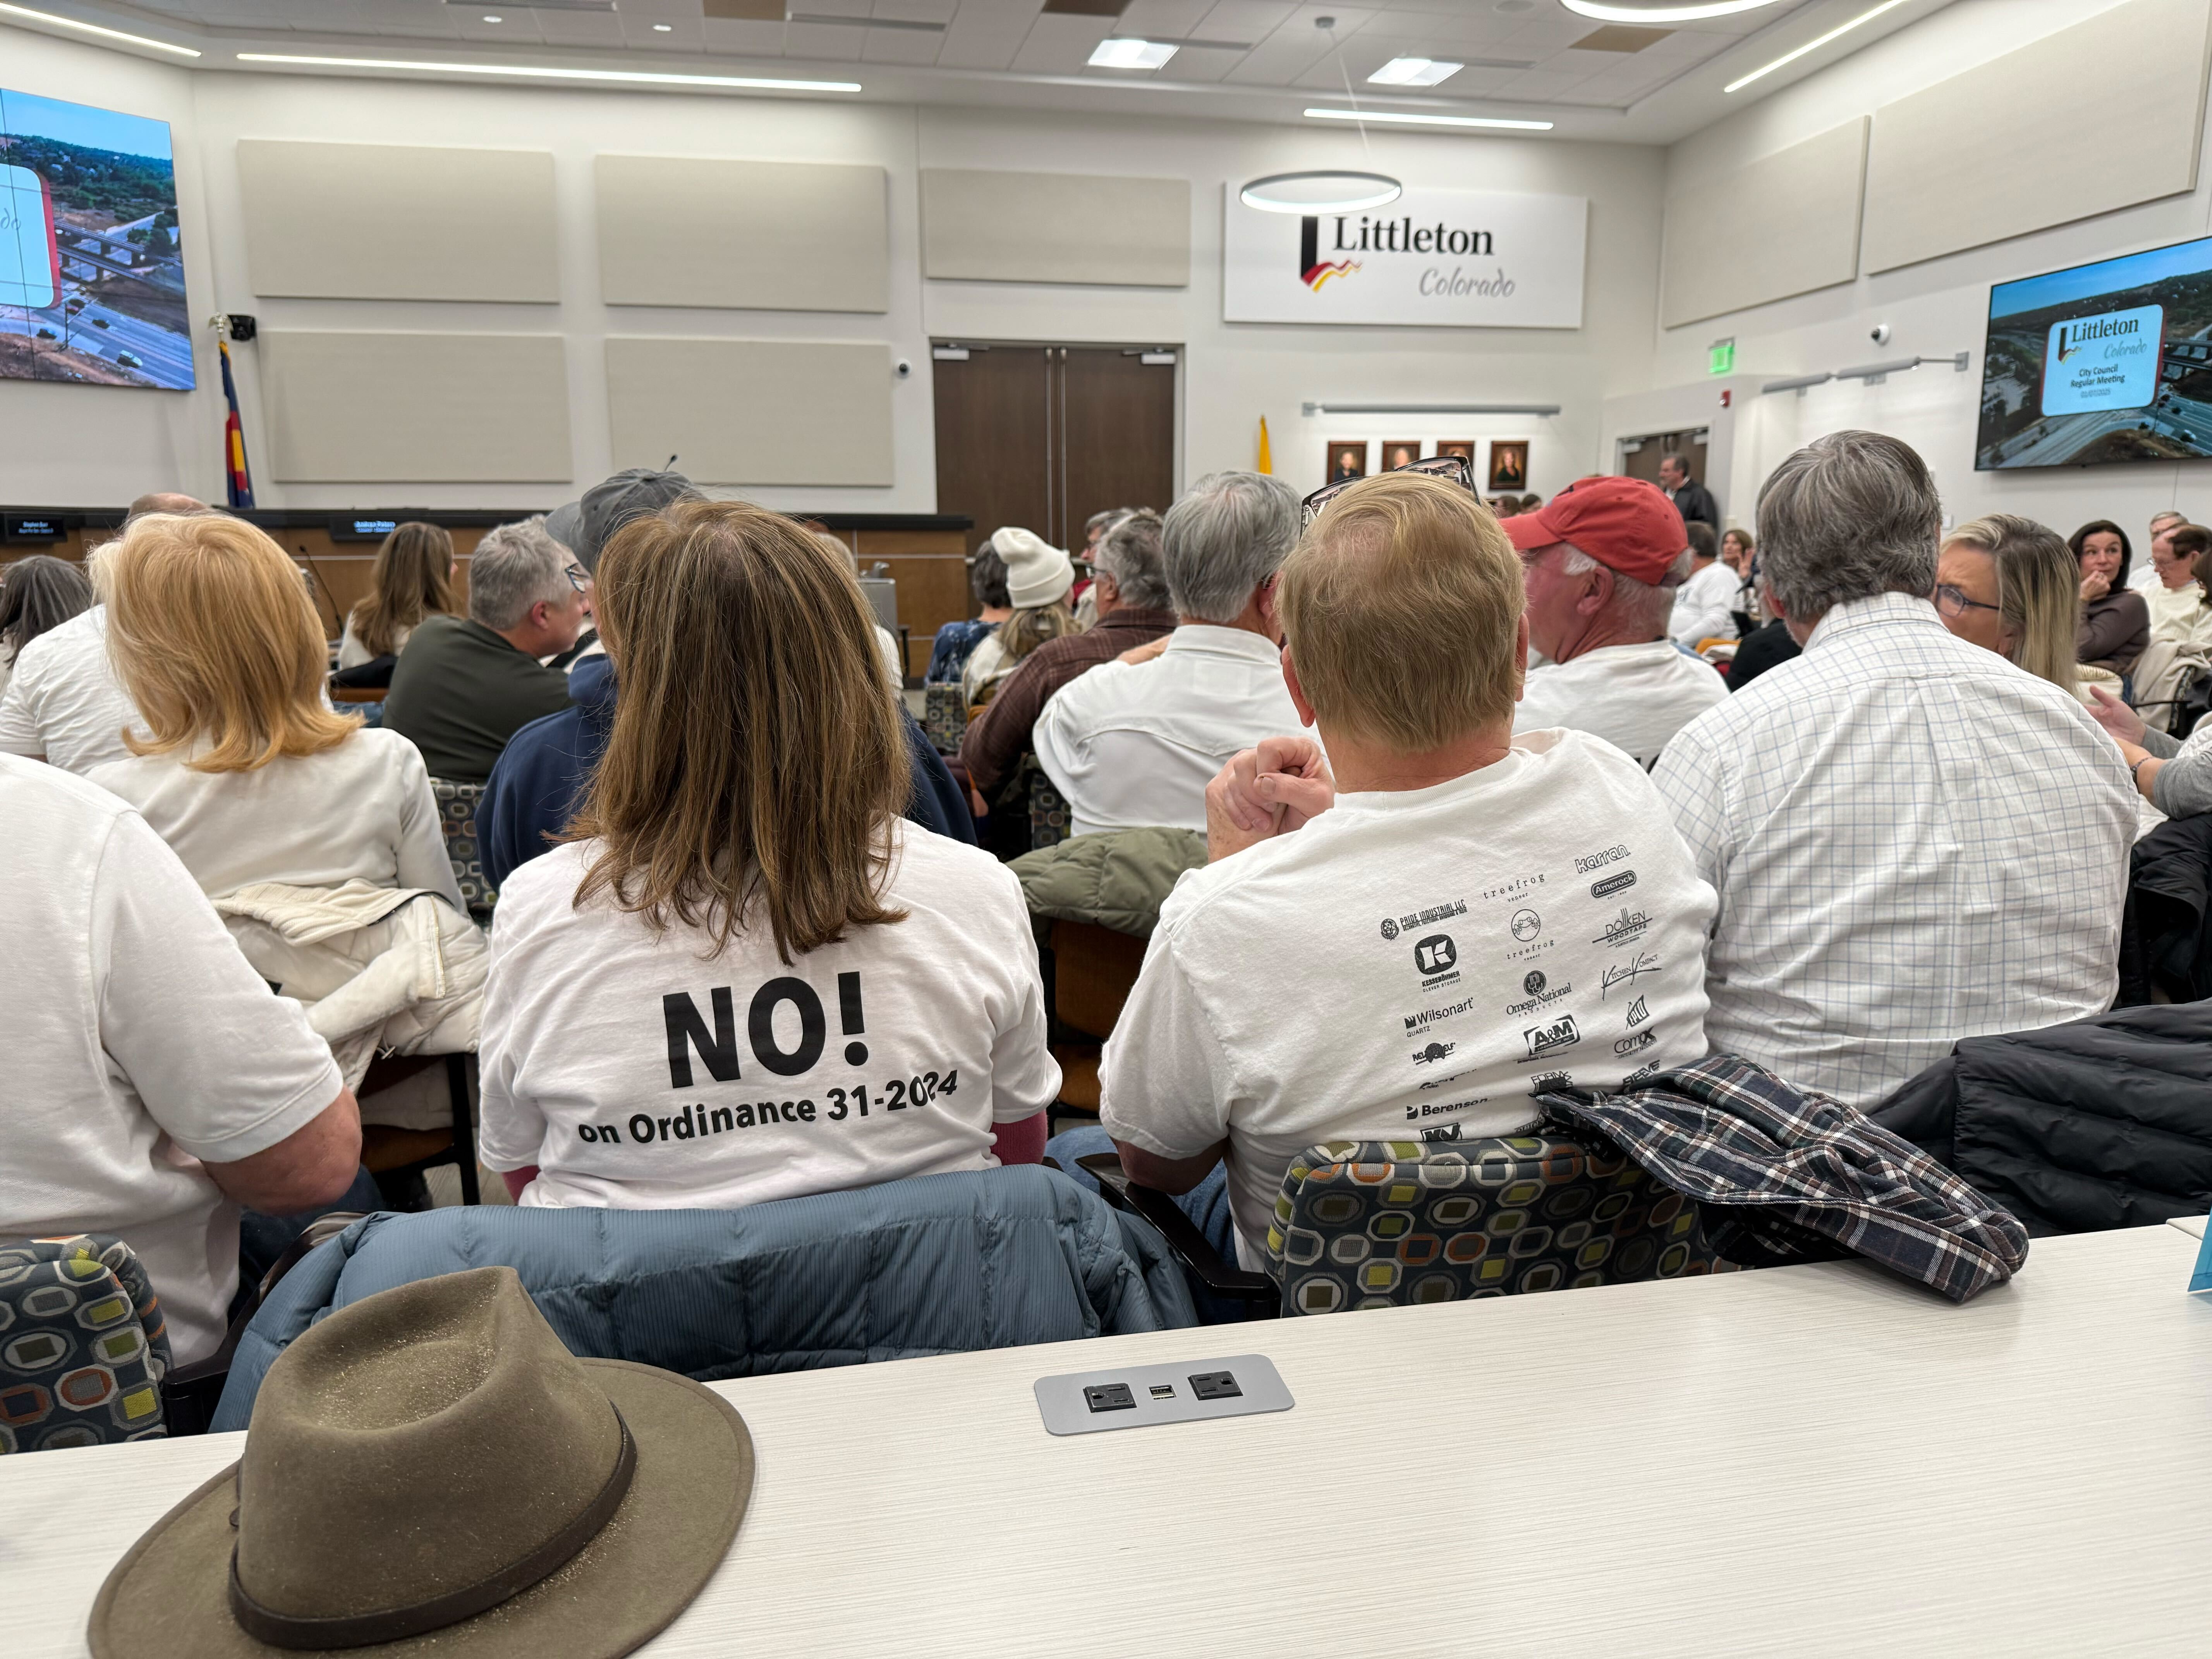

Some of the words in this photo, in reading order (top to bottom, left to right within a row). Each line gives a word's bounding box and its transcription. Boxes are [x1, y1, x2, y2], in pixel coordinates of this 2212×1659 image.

[1333, 216, 1494, 256] Littleton
[1419, 266, 1515, 298] Colorado
[2072, 319, 2138, 342] Littleton
[2104, 338, 2147, 359] Colorado
[2079, 368, 2091, 377] City
[2093, 363, 2118, 375] Council
[2071, 377, 2095, 388] Regular
[2097, 374, 2125, 384] Meeting
[1484, 874, 1545, 899] treefrog
[1595, 874, 1633, 894] Amerock
[1508, 892, 1528, 902] veneer
[1400, 913, 1418, 926] PRIDE
[1419, 903, 1454, 920] INDUSTRIAL
[1455, 899, 1466, 908] LLC
[1607, 923, 1647, 943] WOODTAPE
[1507, 940, 1554, 959] treefrog
[1441, 978, 1461, 987] STORAGE
[1506, 999, 1537, 1015] Omega
[1537, 982, 1572, 1004] National
[1416, 998, 1473, 1025] Wilsonart
[663, 971, 869, 1089] NO!
[1407, 1026, 1431, 1037] QUARTZ
[578, 1124, 621, 1144] on
[629, 1098, 816, 1144] Ordinance
[827, 1070, 957, 1120] 31-2024
[1422, 1098, 1488, 1116] Berenson
